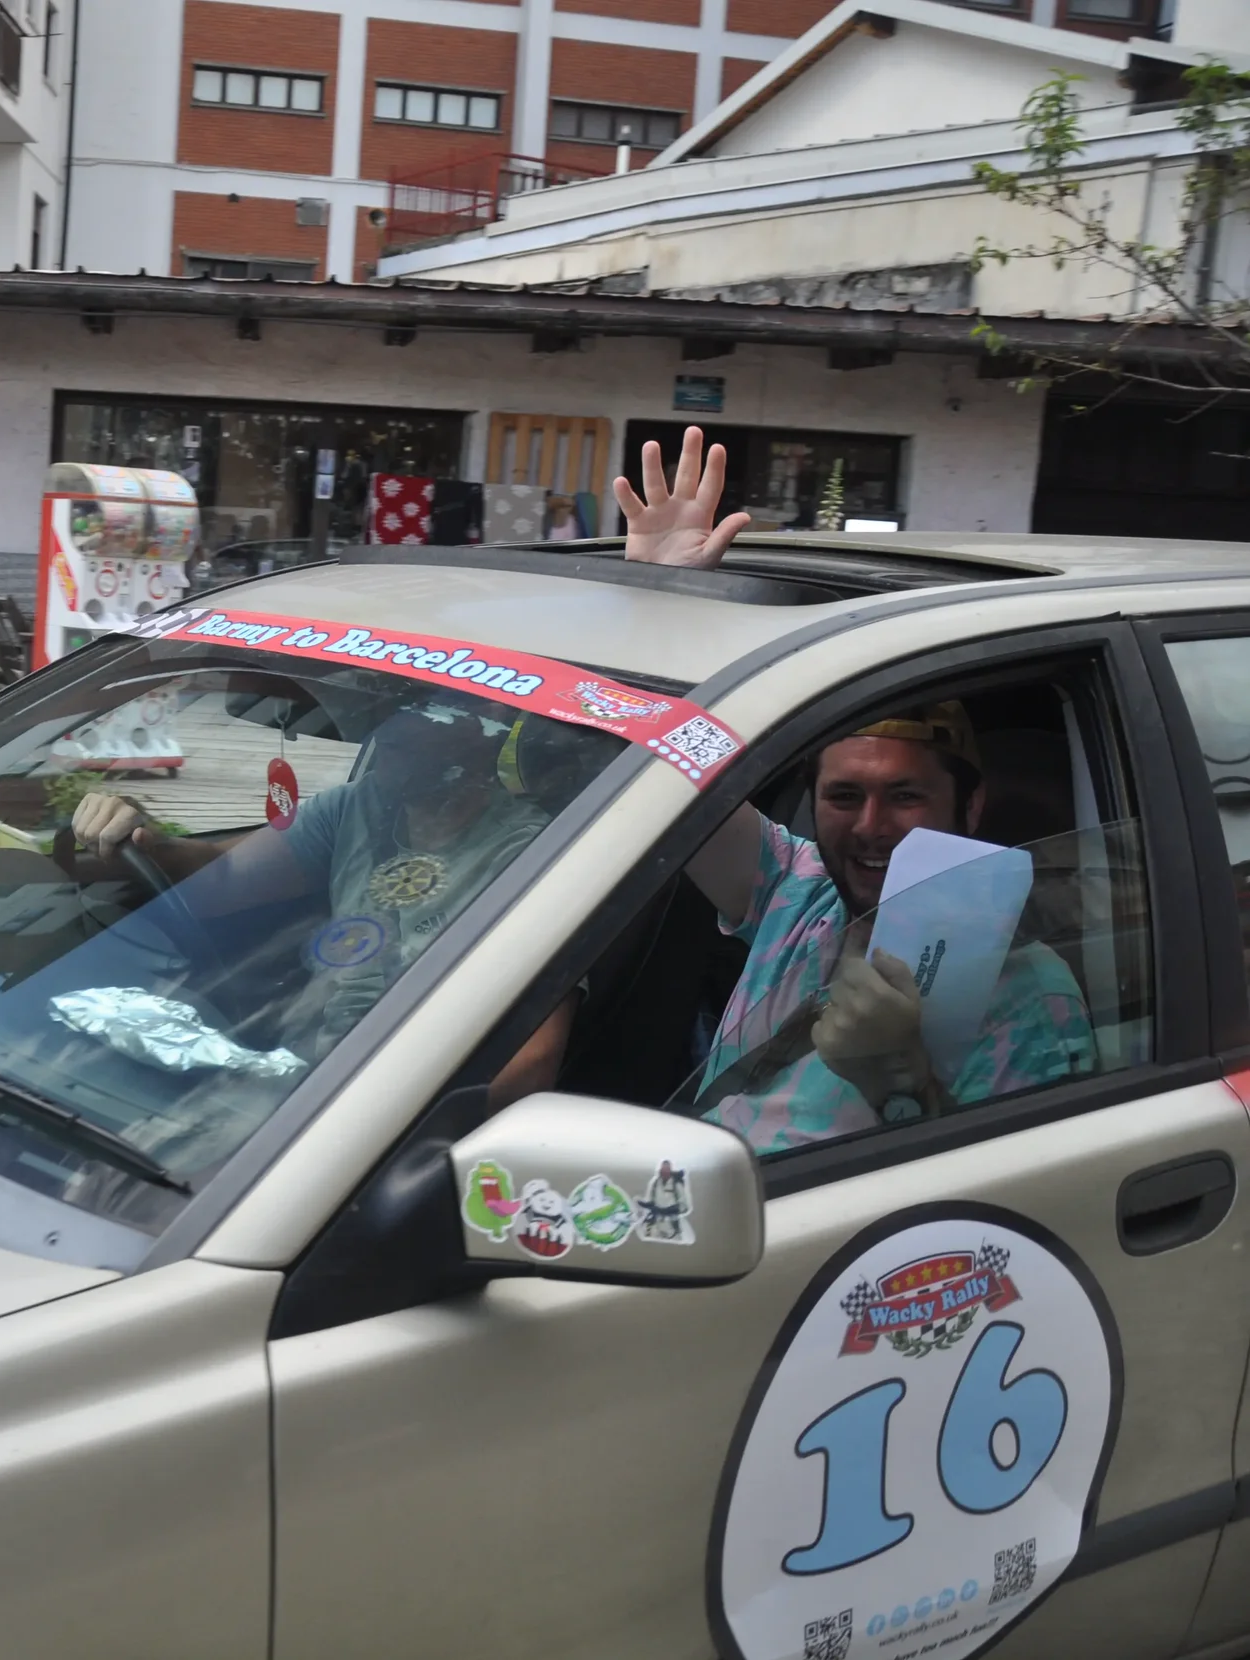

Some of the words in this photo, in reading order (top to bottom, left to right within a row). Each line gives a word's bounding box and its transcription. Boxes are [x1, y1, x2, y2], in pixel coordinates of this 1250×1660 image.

[186, 614, 291, 646] Barmy
[281, 626, 330, 648] to
[320, 628, 545, 697] Barcelona
[581, 690, 616, 710] Wacky
[617, 705, 651, 716] Rally
[868, 1301, 937, 1328] Wacky
[940, 1275, 989, 1311] Rally
[781, 1320, 1068, 1576] 16
